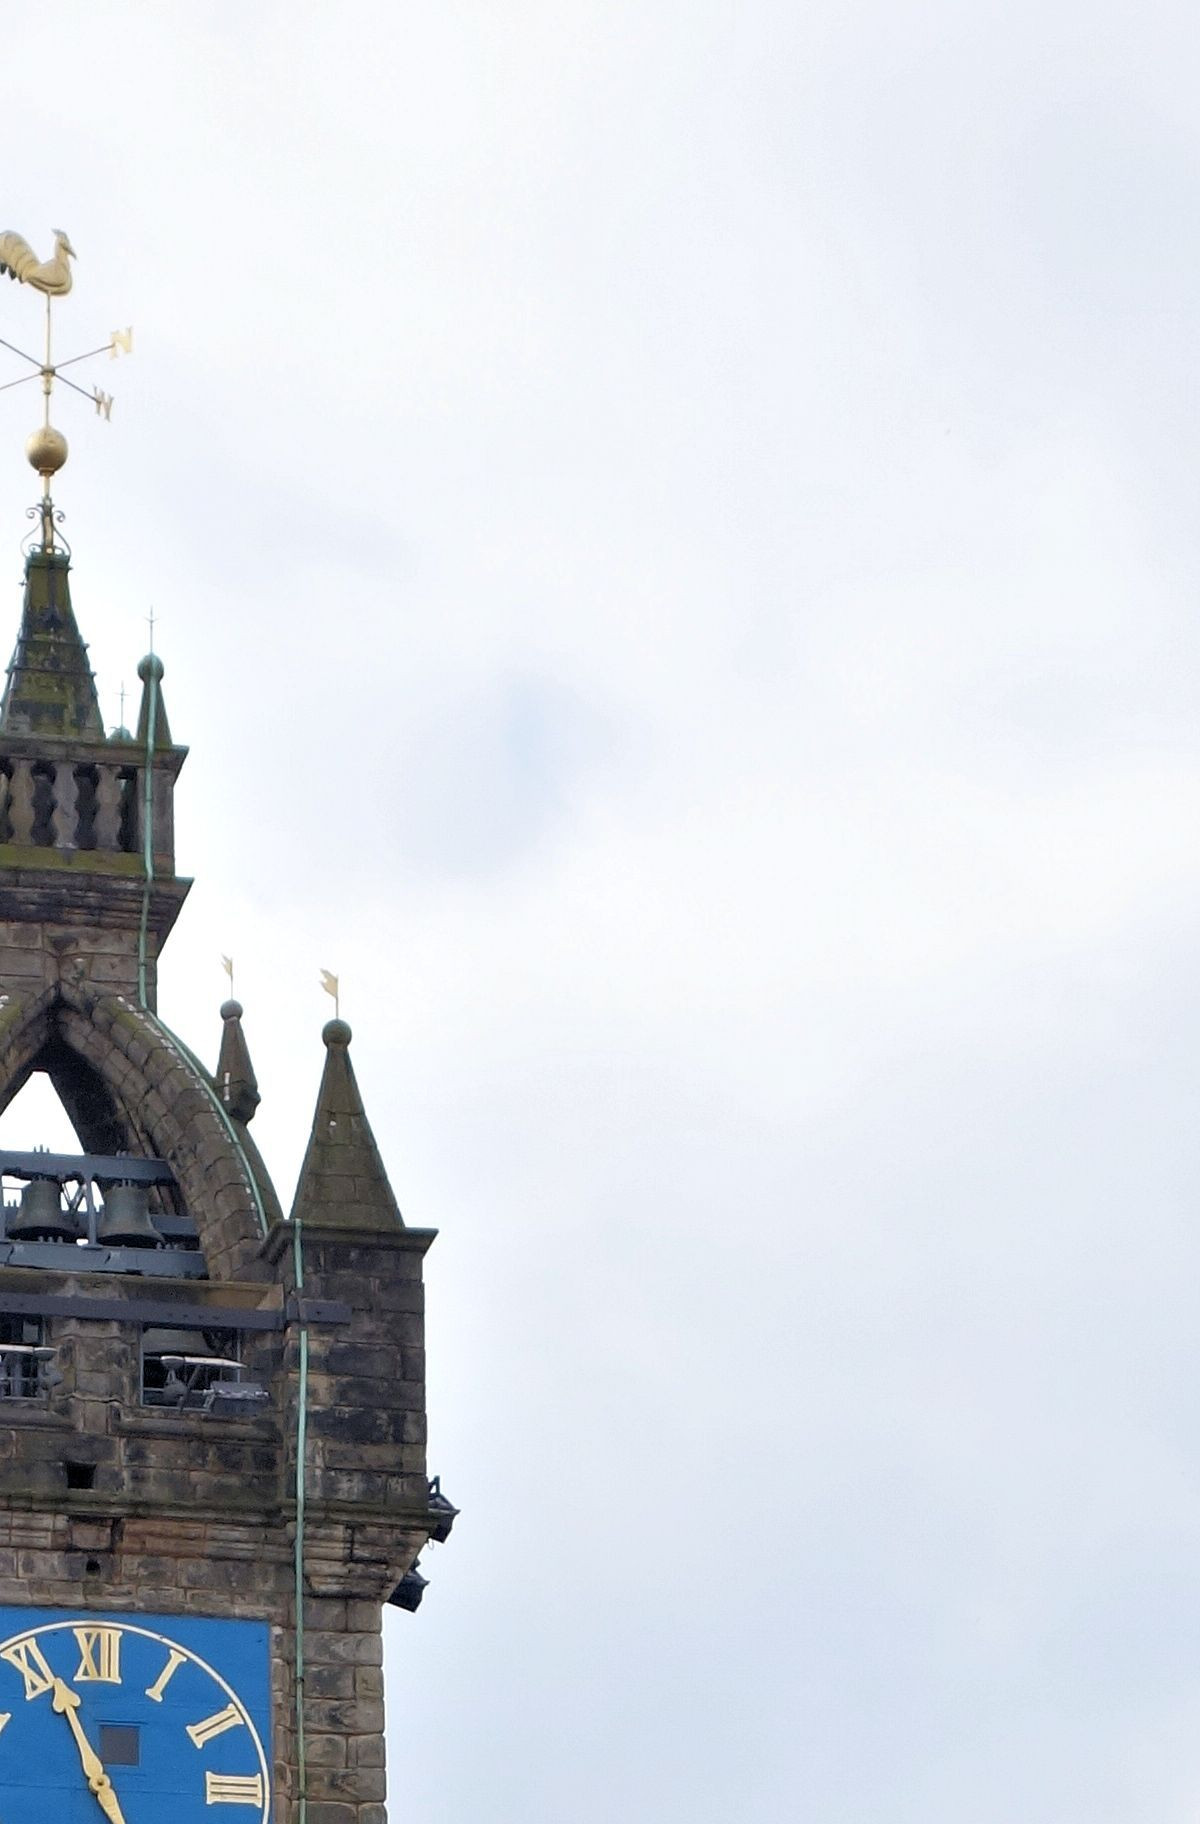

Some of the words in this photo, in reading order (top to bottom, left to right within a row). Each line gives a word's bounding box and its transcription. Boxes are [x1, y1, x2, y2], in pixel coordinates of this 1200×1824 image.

[0, 1637, 55, 1701] XI
[73, 1628, 123, 1684] XII
[145, 1649, 188, 1701] I
[186, 1703, 244, 1749] II
[206, 1772, 262, 1808] III
